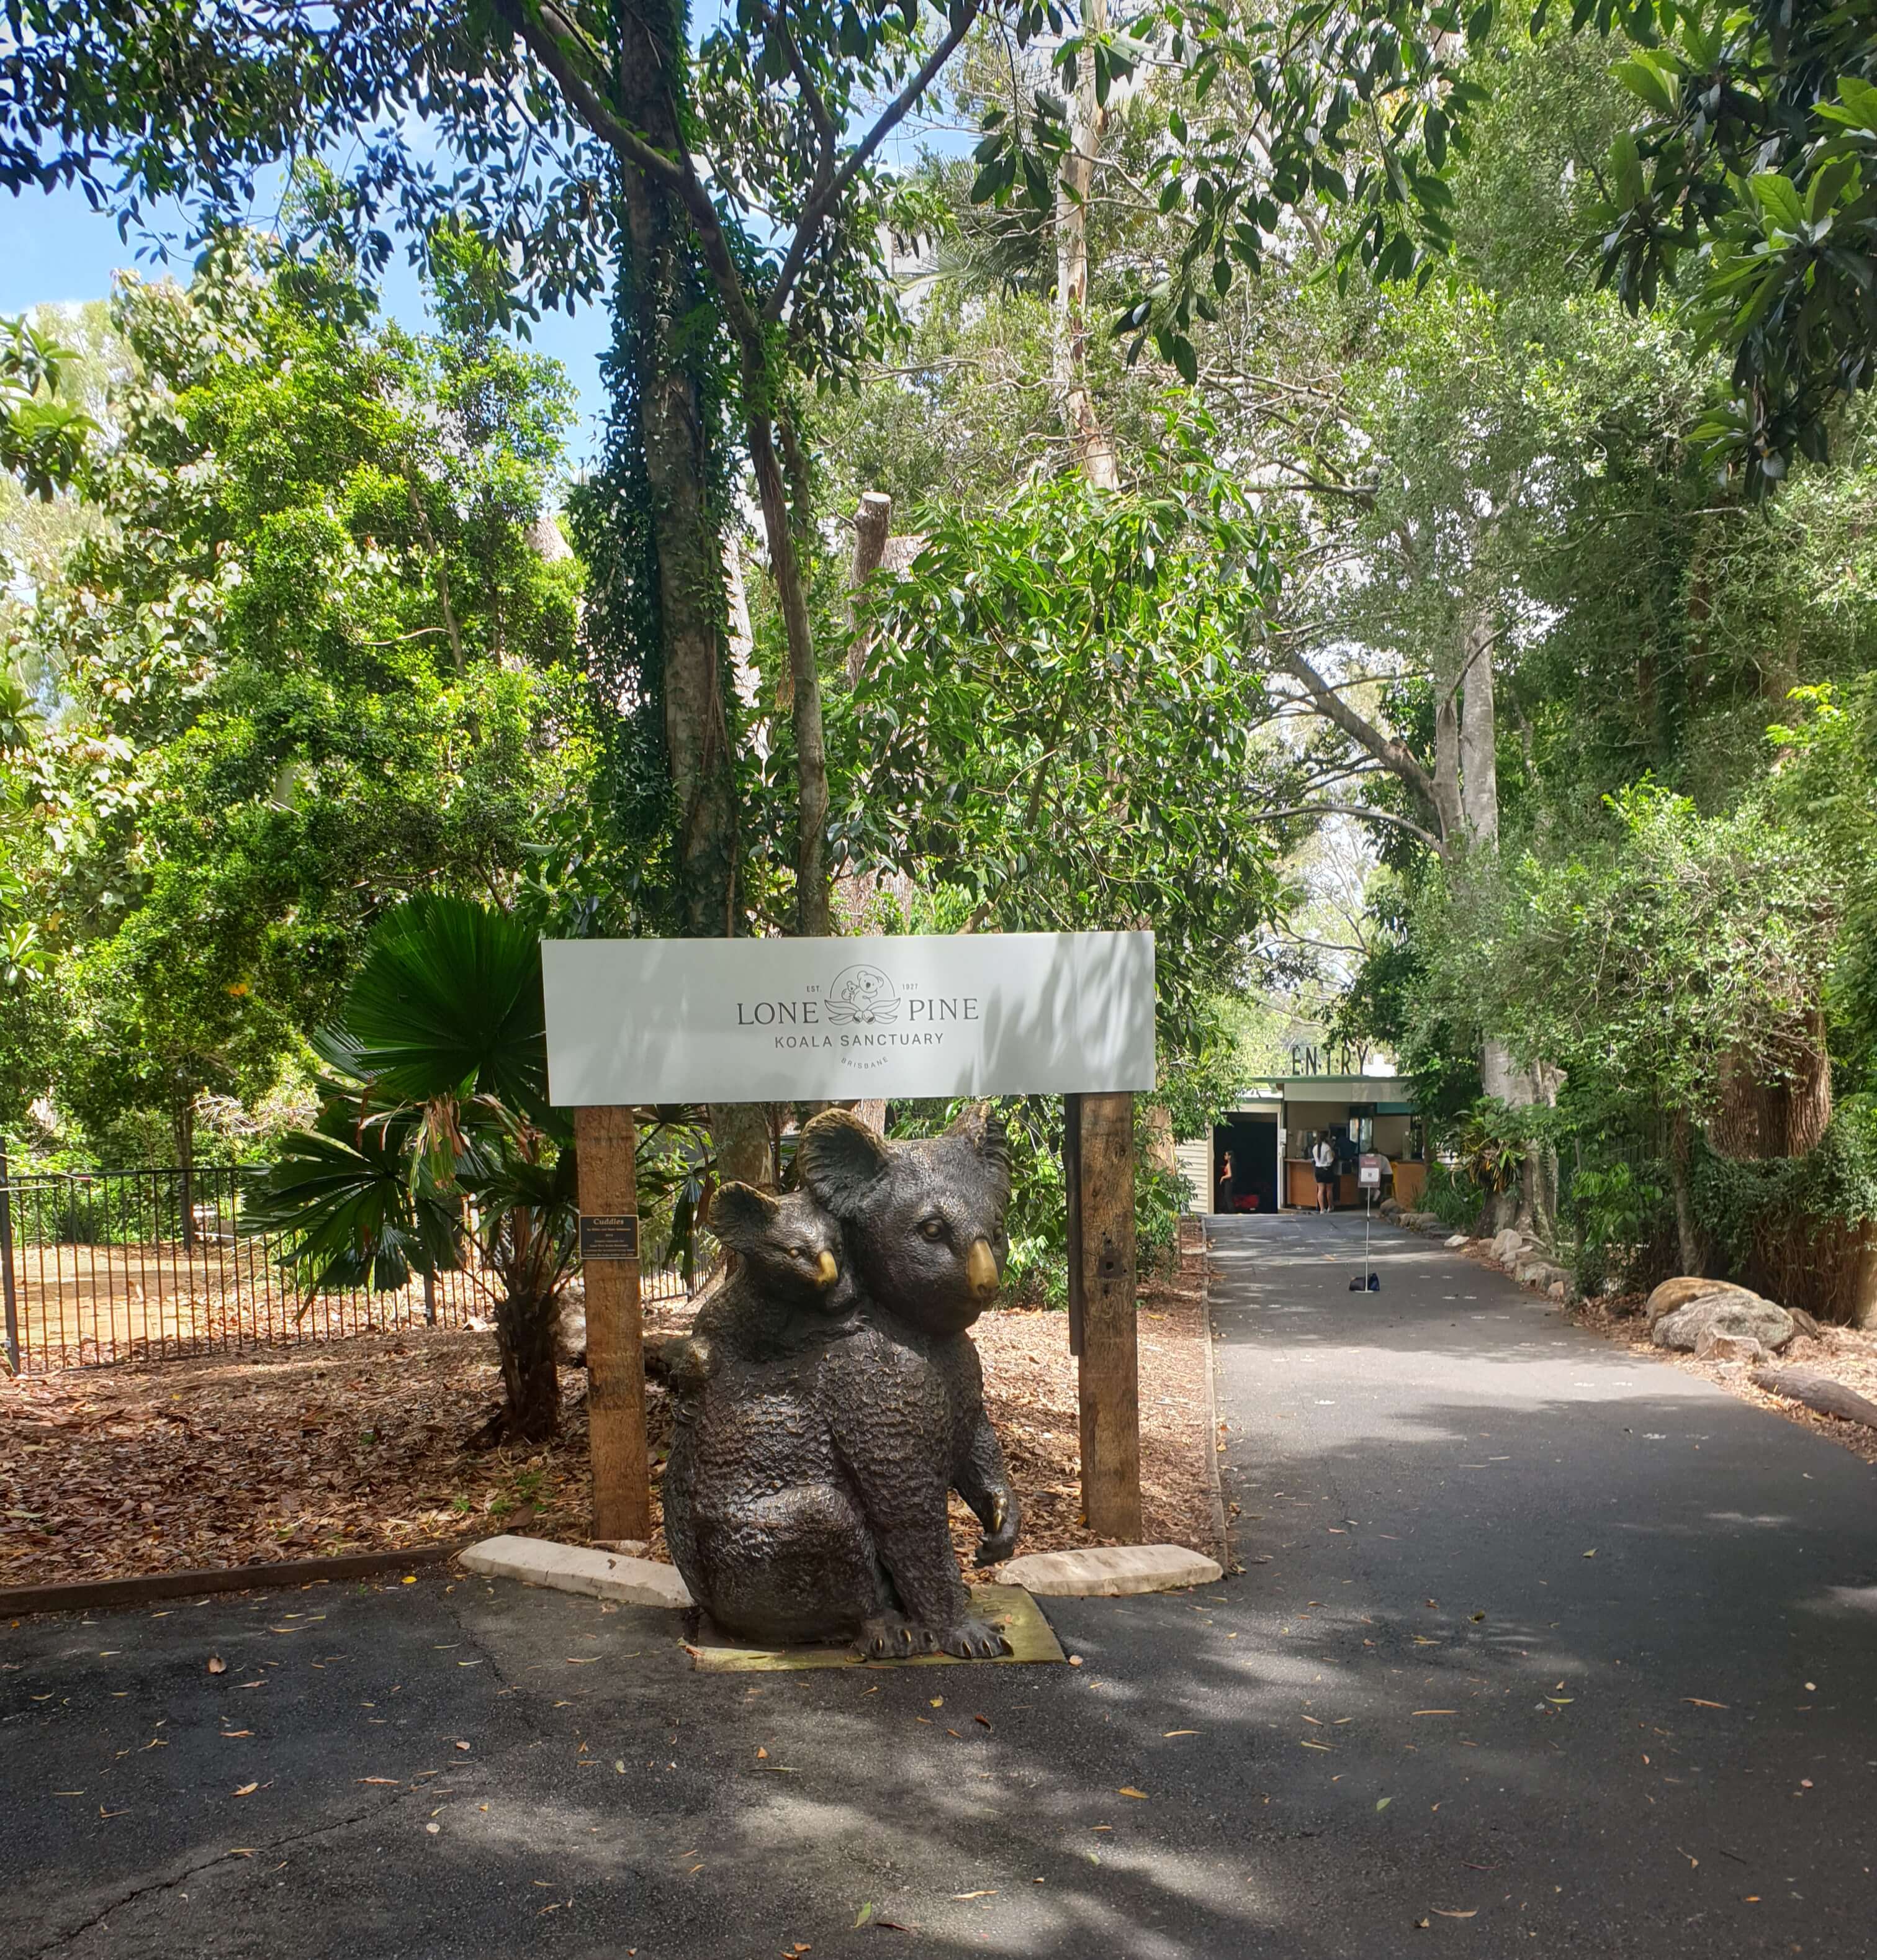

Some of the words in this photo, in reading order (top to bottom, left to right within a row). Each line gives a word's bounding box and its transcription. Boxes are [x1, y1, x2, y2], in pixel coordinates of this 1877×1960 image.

[806, 985, 822, 993] EST.
[902, 983, 919, 991] 1927
[737, 1001, 819, 1025] LONE
[909, 998, 979, 1021] PINE
[775, 1035, 833, 1049] KOALA
[840, 1032, 944, 1046] SANCTUARY
[841, 1056, 889, 1069] BRISBANE
[1292, 1044, 1369, 1075] ENTRY
